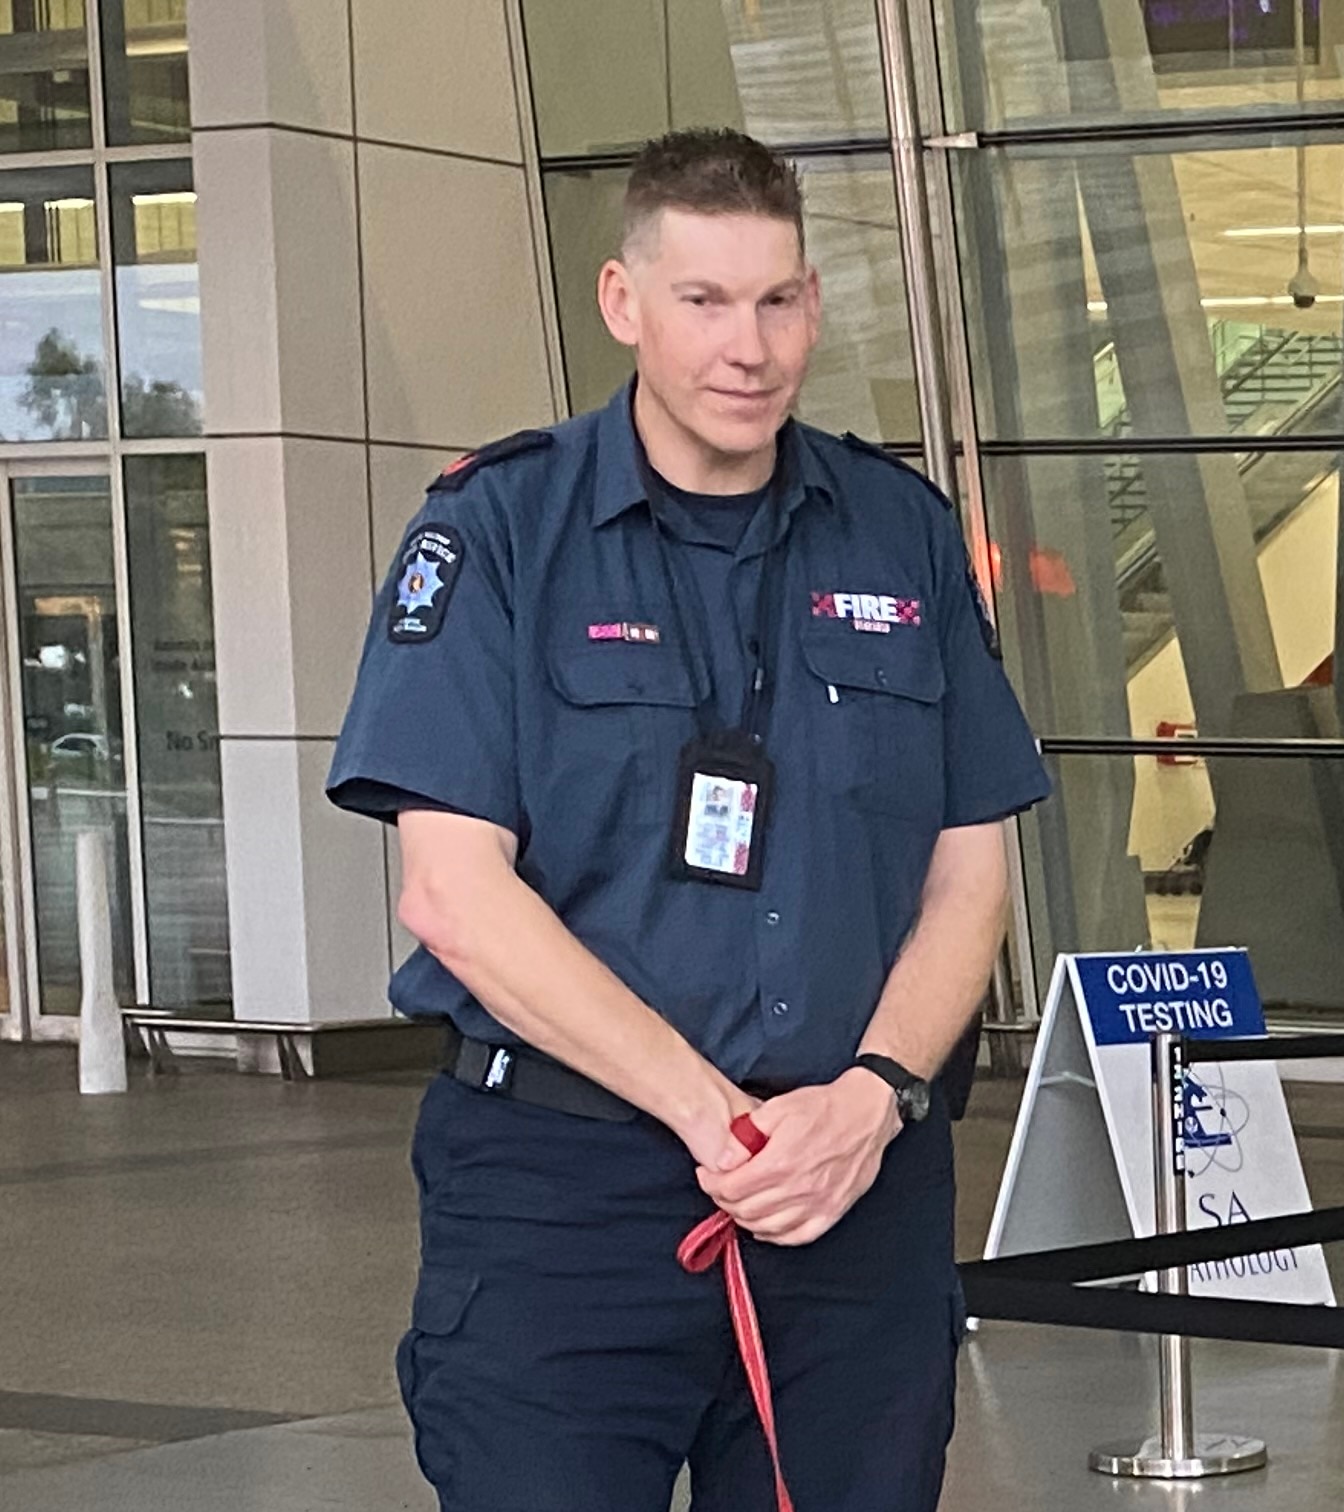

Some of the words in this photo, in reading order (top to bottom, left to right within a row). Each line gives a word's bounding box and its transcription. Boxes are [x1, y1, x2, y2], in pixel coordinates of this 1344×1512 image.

[833, 593, 900, 622] FIRE
[1107, 960, 1228, 995] COVID-19
[1119, 998, 1233, 1033] TESTING
[1199, 1190, 1252, 1227] SA
